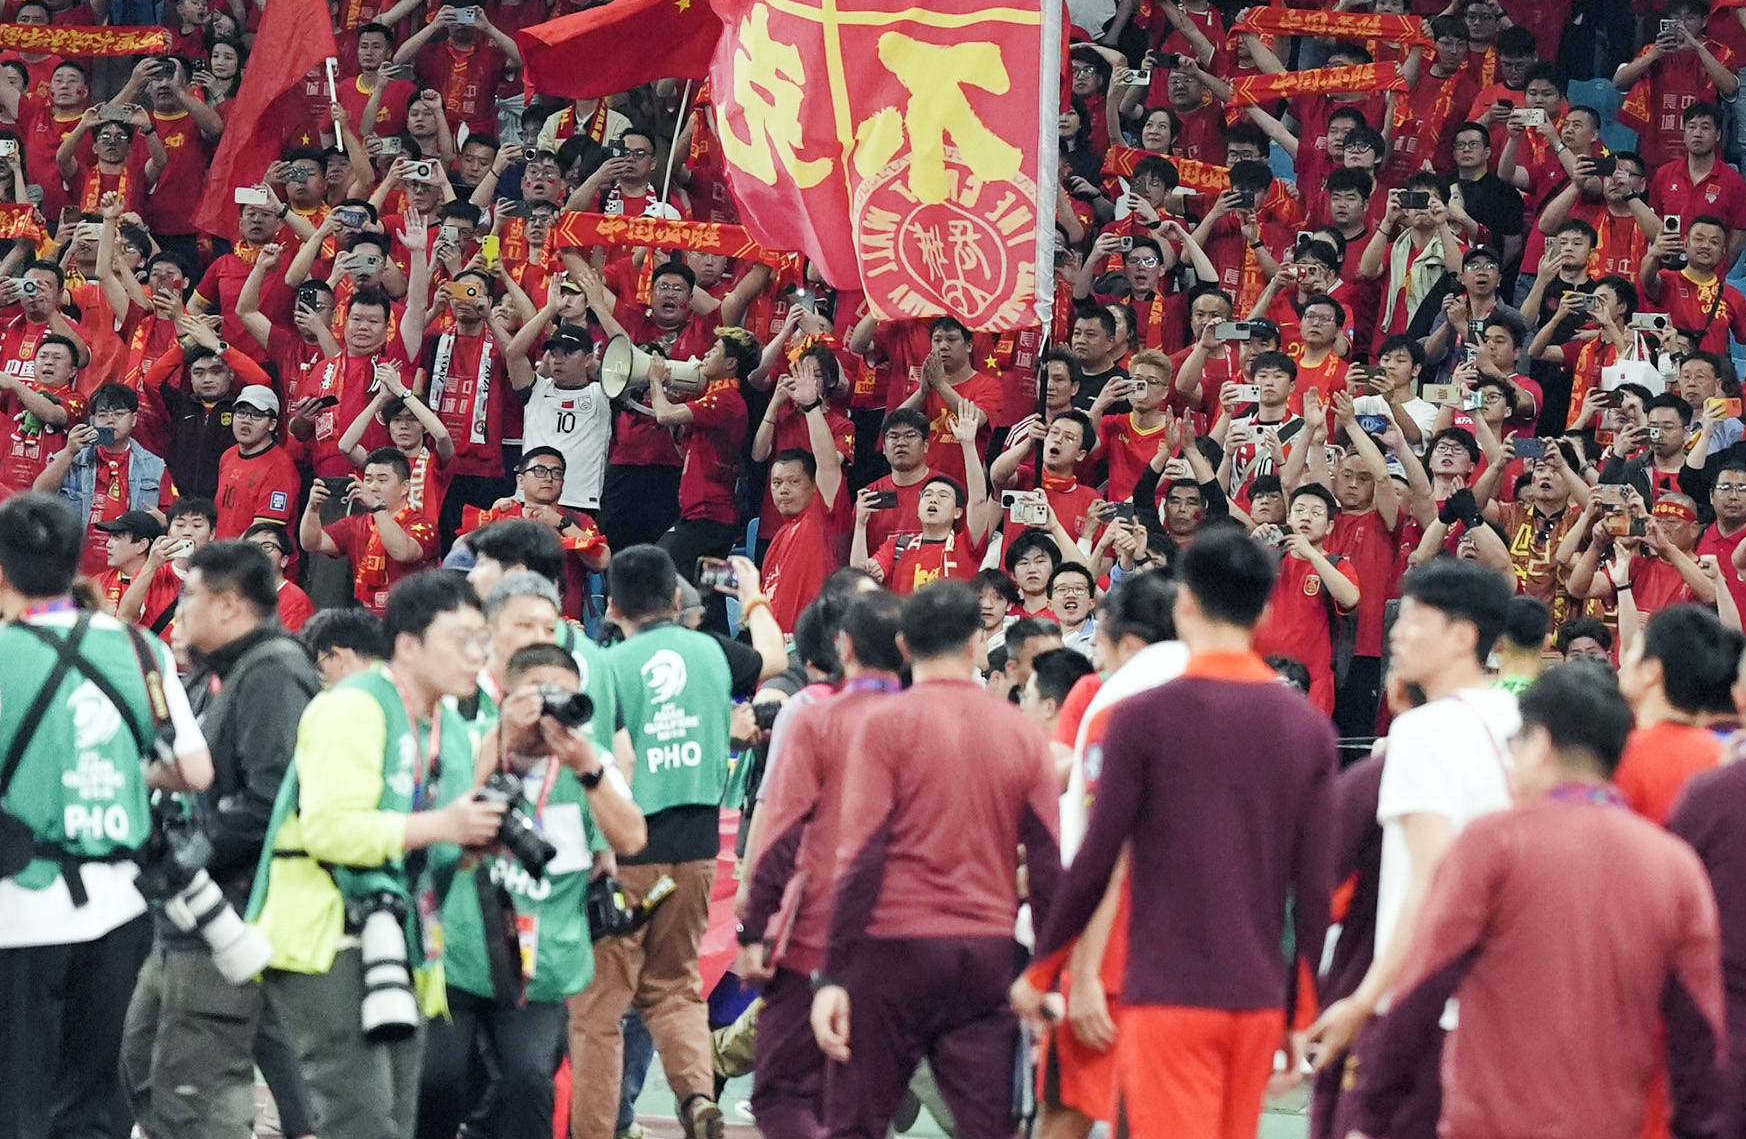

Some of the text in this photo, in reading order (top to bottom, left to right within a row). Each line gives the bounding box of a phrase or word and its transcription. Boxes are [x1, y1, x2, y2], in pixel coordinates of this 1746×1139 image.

[596, 217, 722, 249] 中国必胜
[556, 411, 577, 435] 10
[646, 740, 703, 775] PHO
[64, 803, 129, 842] PHO
